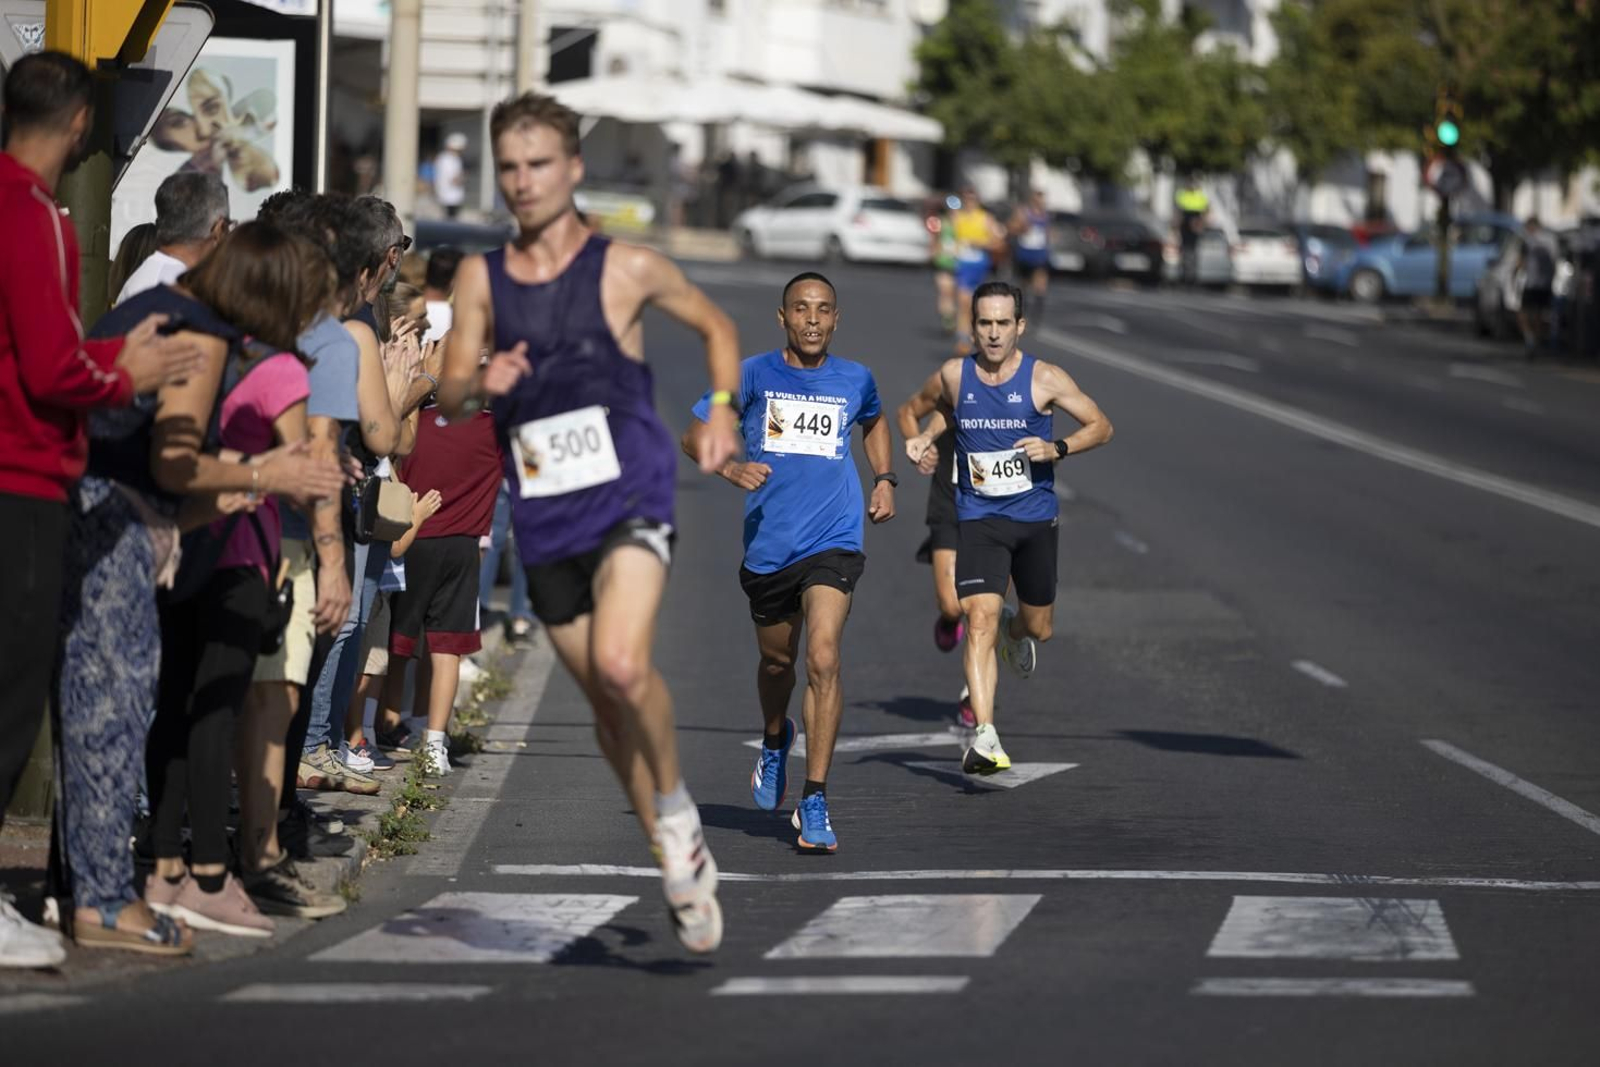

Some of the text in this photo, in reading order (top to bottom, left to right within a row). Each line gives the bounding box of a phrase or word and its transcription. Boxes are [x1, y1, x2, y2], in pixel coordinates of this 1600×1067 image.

[775, 392, 807, 401] VUELTA
[816, 396, 847, 404] HUELVA
[793, 412, 832, 436] 449
[960, 418, 1027, 429] TROTASIERRA
[549, 425, 601, 462] 500
[991, 458, 1025, 479] 469
